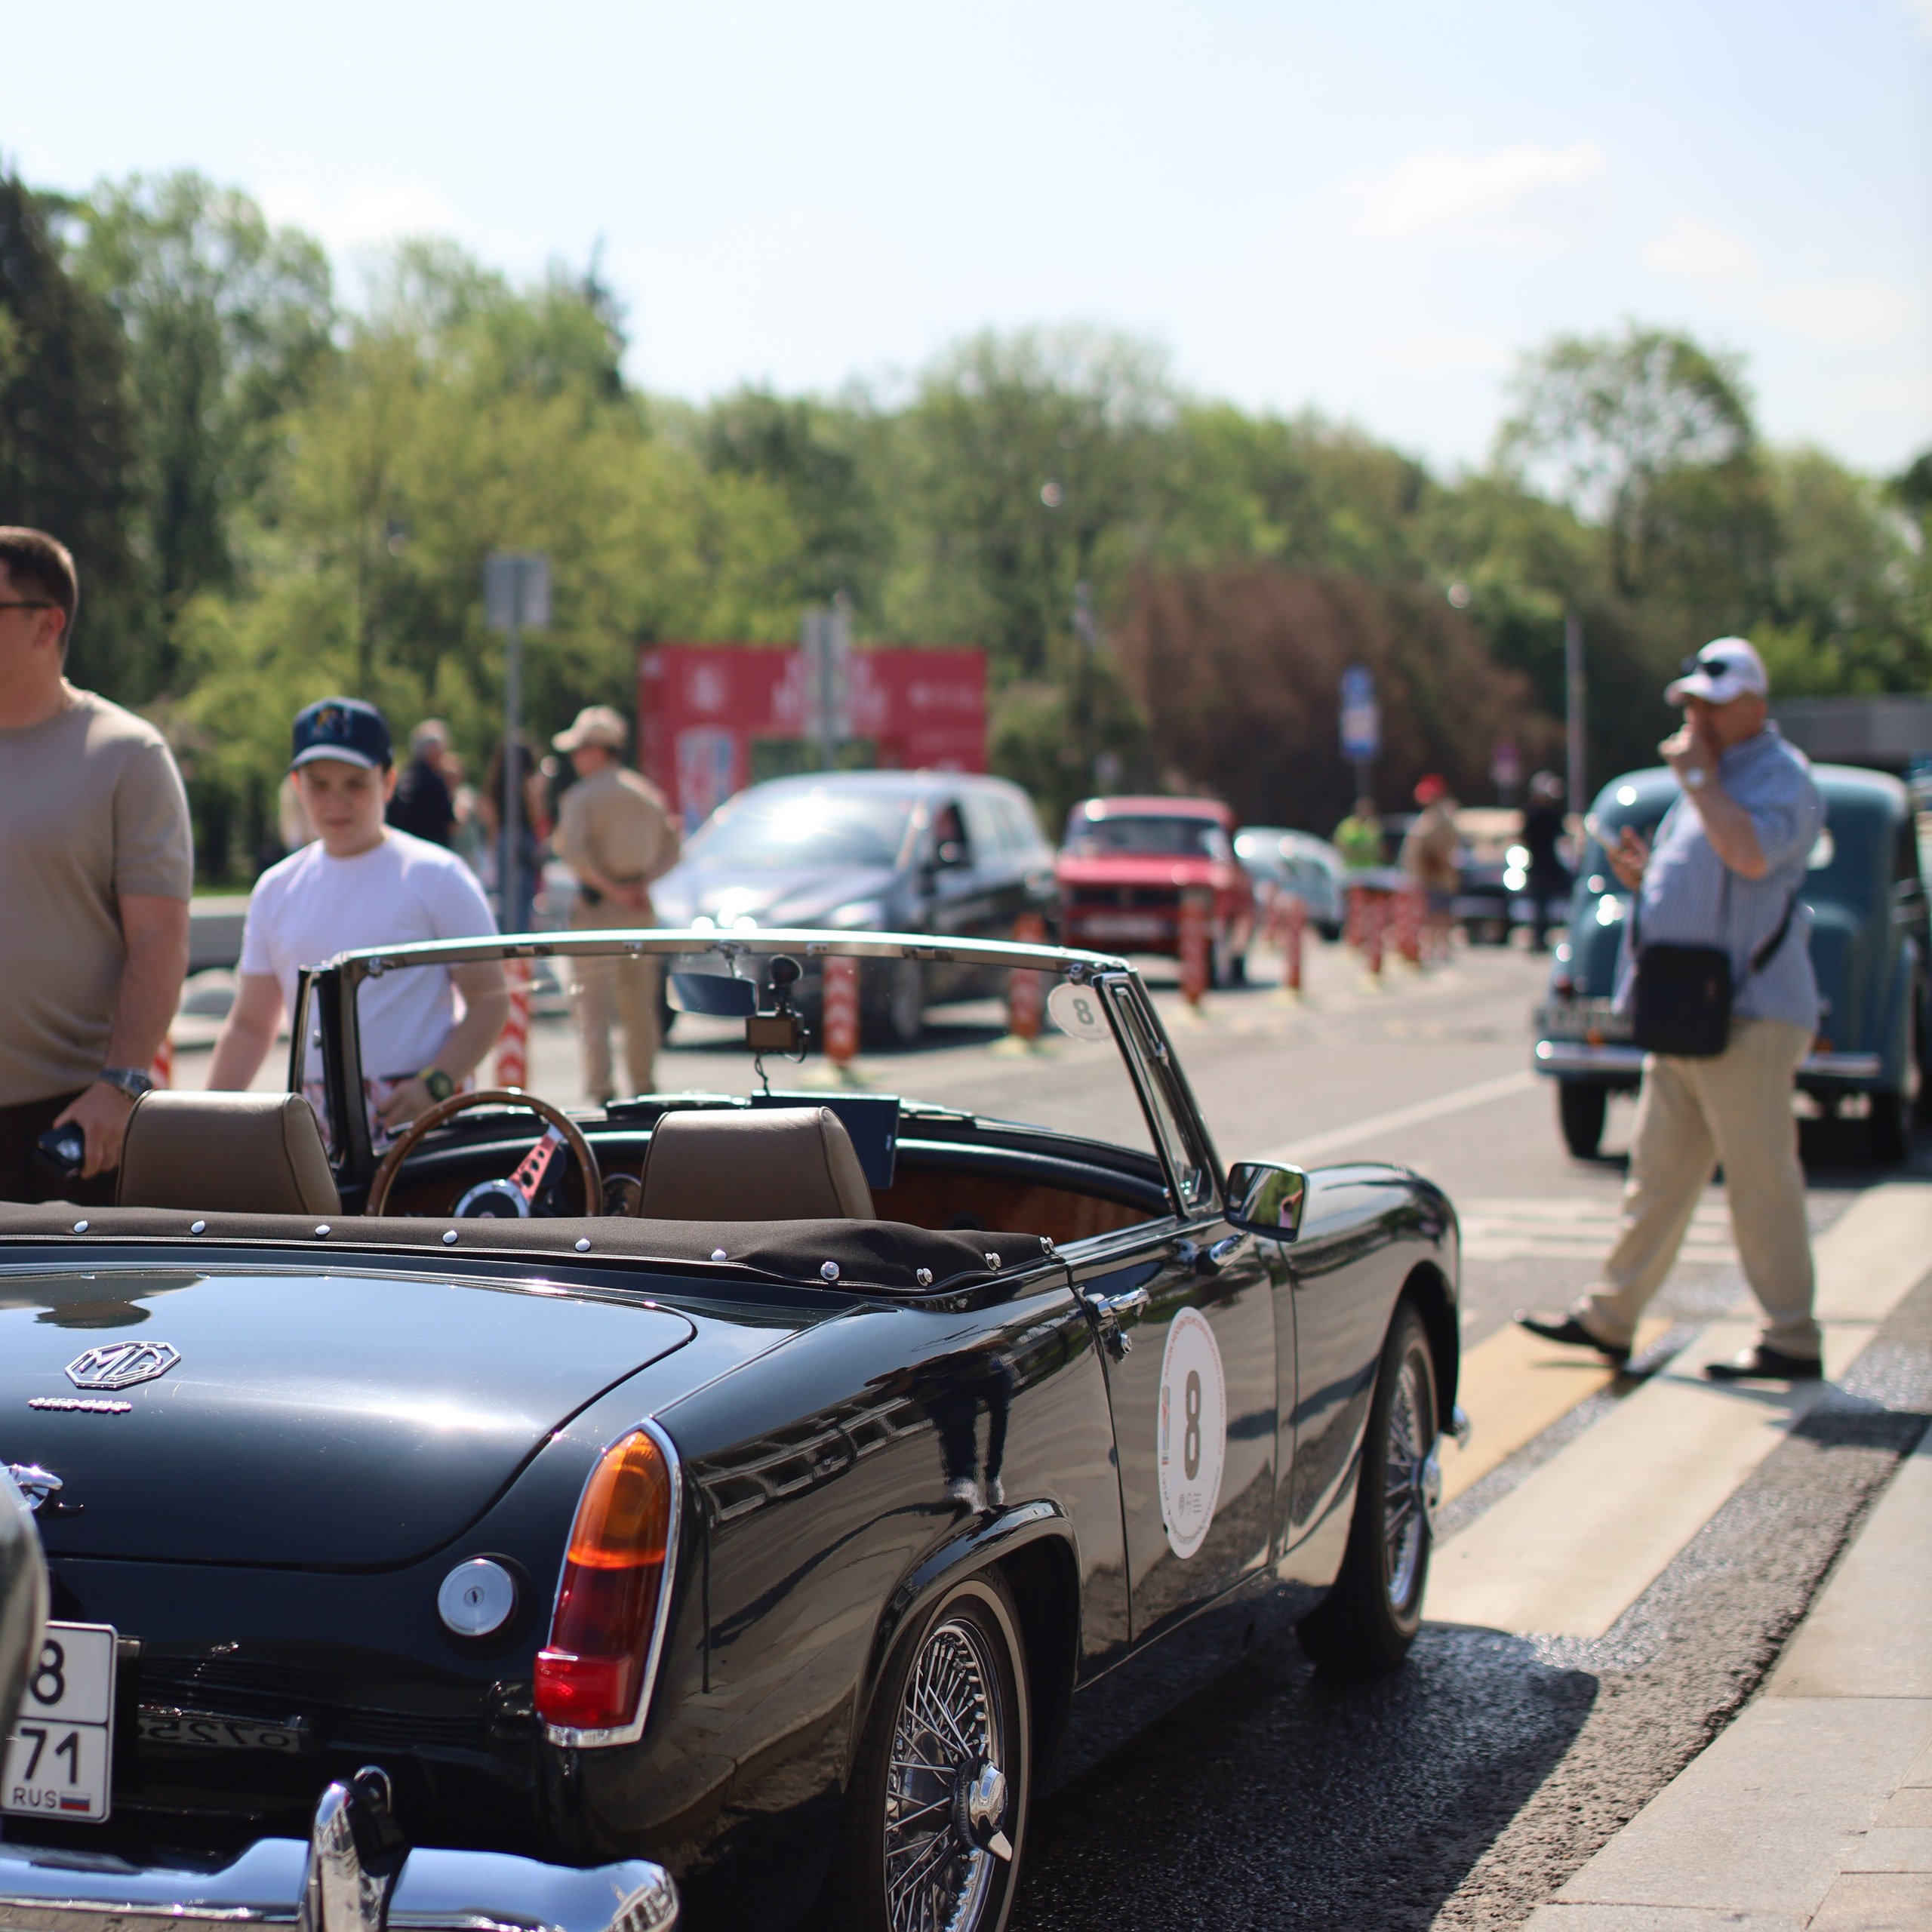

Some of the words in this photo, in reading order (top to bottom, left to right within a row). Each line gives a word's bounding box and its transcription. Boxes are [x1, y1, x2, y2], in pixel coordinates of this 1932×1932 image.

[1072, 998, 1094, 1025] 8
[79, 1346, 163, 1380] MG
[1184, 1370, 1201, 1481] 8
[30, 1638, 65, 1706] 8
[21, 1727, 79, 1784] 71
[13, 1786, 57, 1808] RUS
